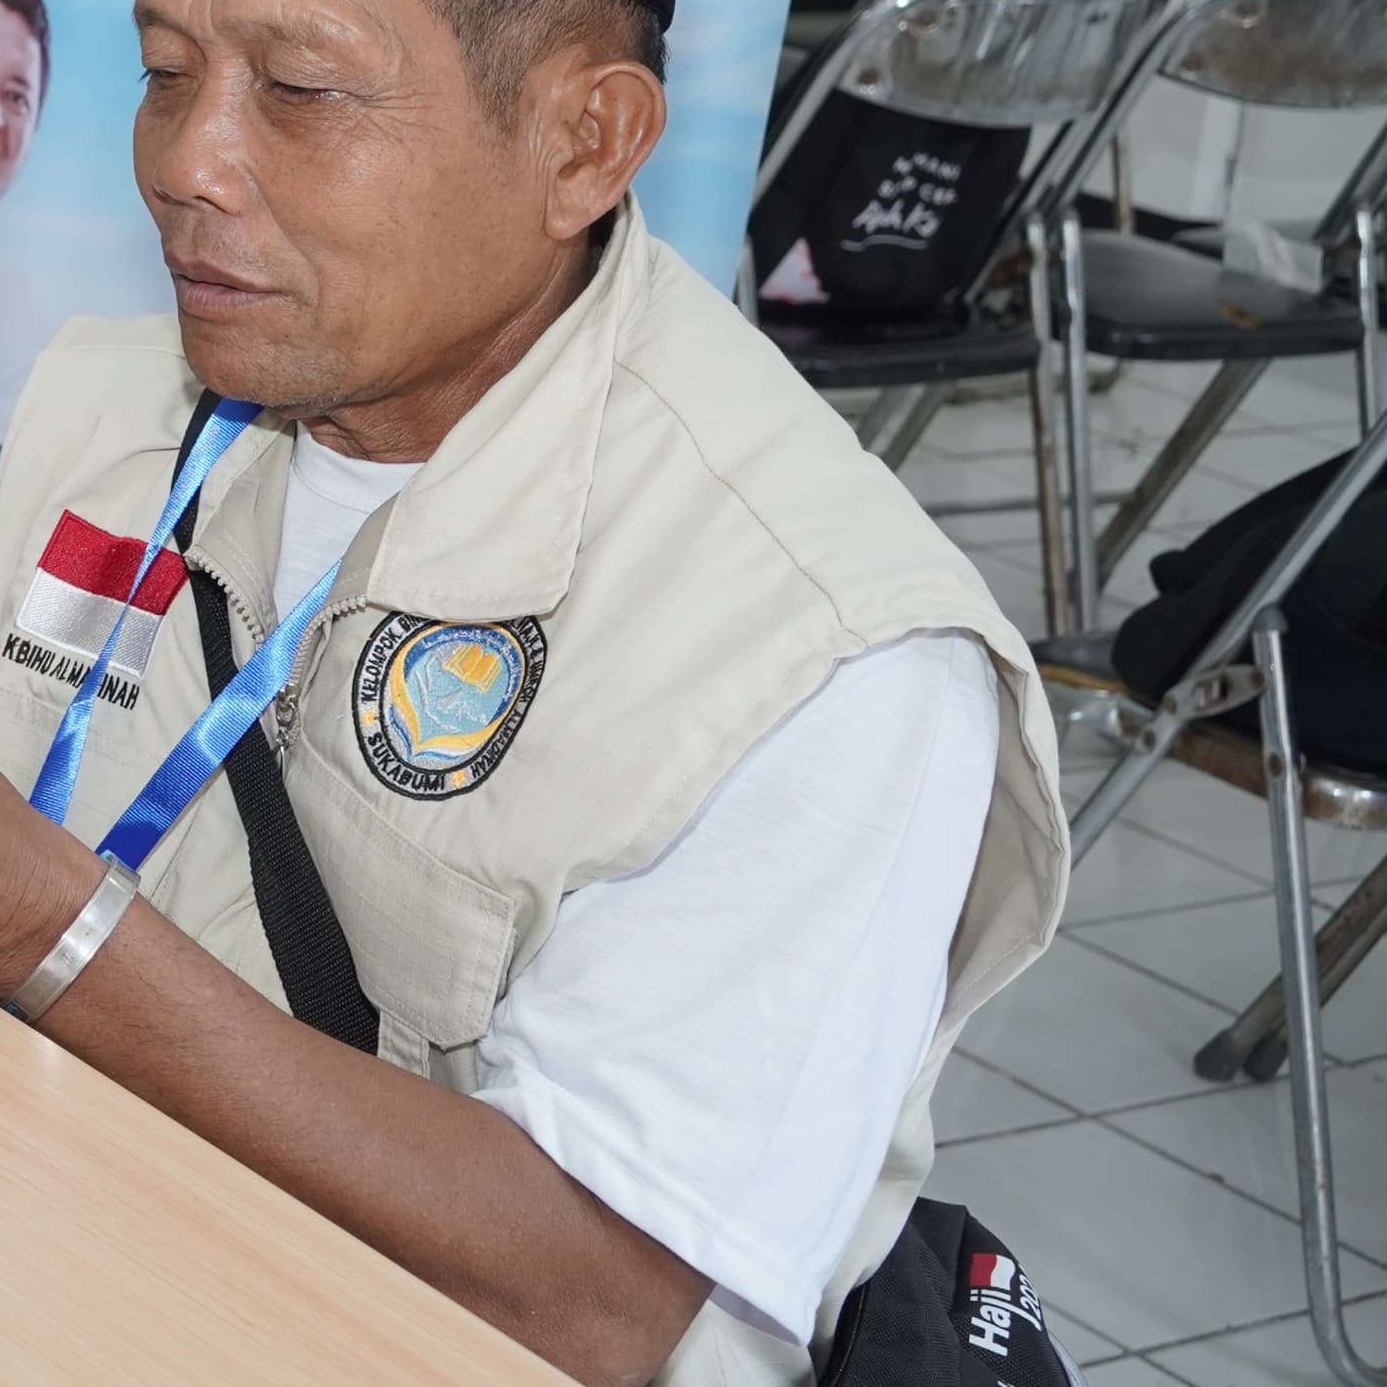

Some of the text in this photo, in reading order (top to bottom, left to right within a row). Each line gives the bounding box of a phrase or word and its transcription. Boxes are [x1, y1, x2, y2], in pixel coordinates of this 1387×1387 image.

[1, 632, 56, 676] KBIHU
[367, 732, 447, 791] SUKABUMI
[968, 1288, 1042, 1357] Haji
